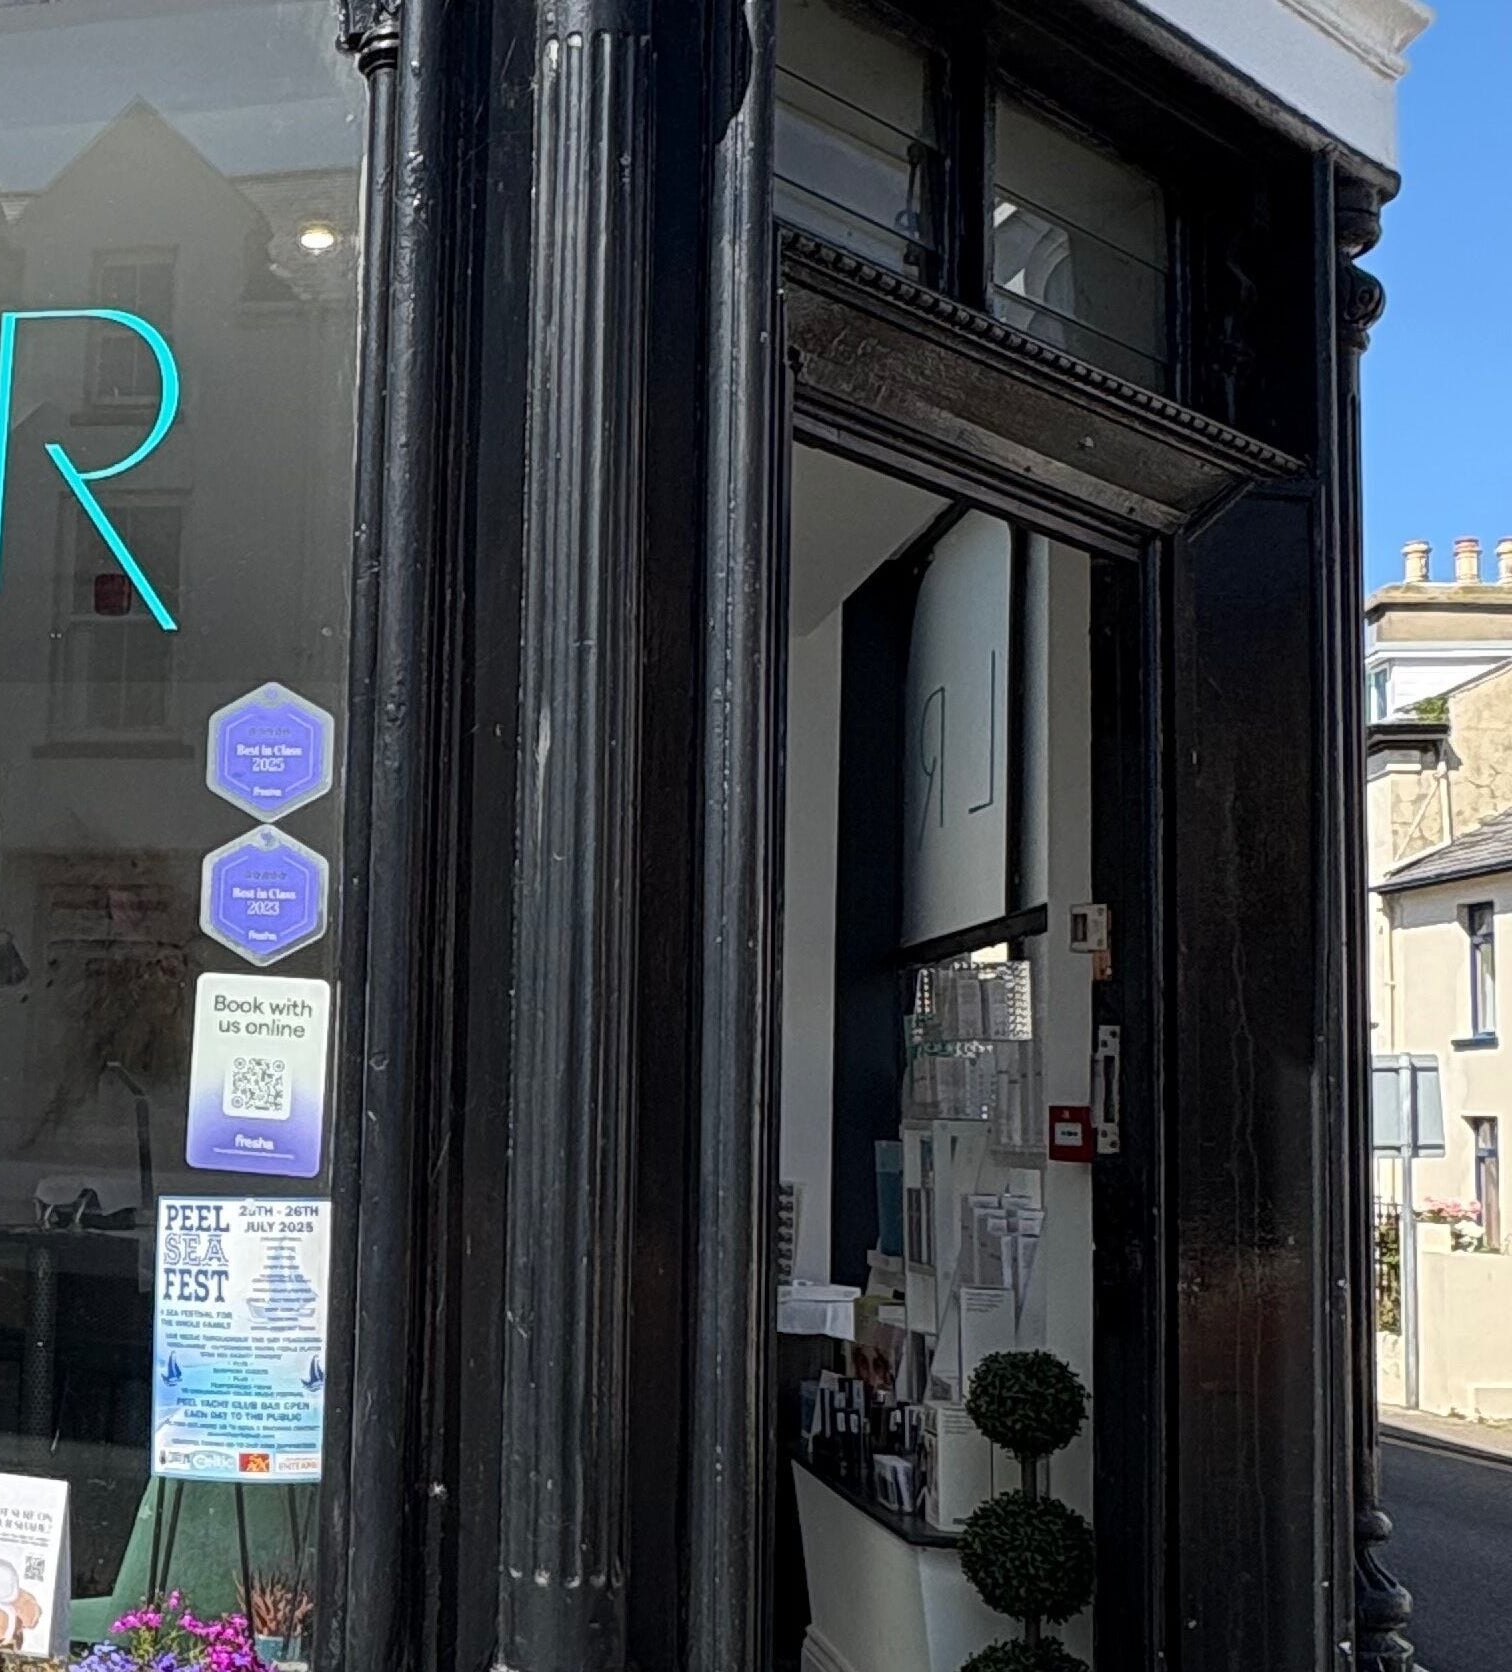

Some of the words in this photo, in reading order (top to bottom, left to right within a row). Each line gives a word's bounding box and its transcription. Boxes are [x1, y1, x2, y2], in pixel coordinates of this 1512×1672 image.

[214, 995, 265, 1015] Book
[270, 998, 313, 1018] with
[218, 1019, 242, 1034] us
[245, 1019, 306, 1038] online
[234, 1133, 275, 1150] fresha
[165, 1204, 230, 1233] PEEL
[284, 1205, 320, 1217] 26TH
[244, 1221, 276, 1233] JULY
[278, 1221, 314, 1233] 2025
[164, 1232, 230, 1267] SEA
[163, 1267, 230, 1303] FEST
